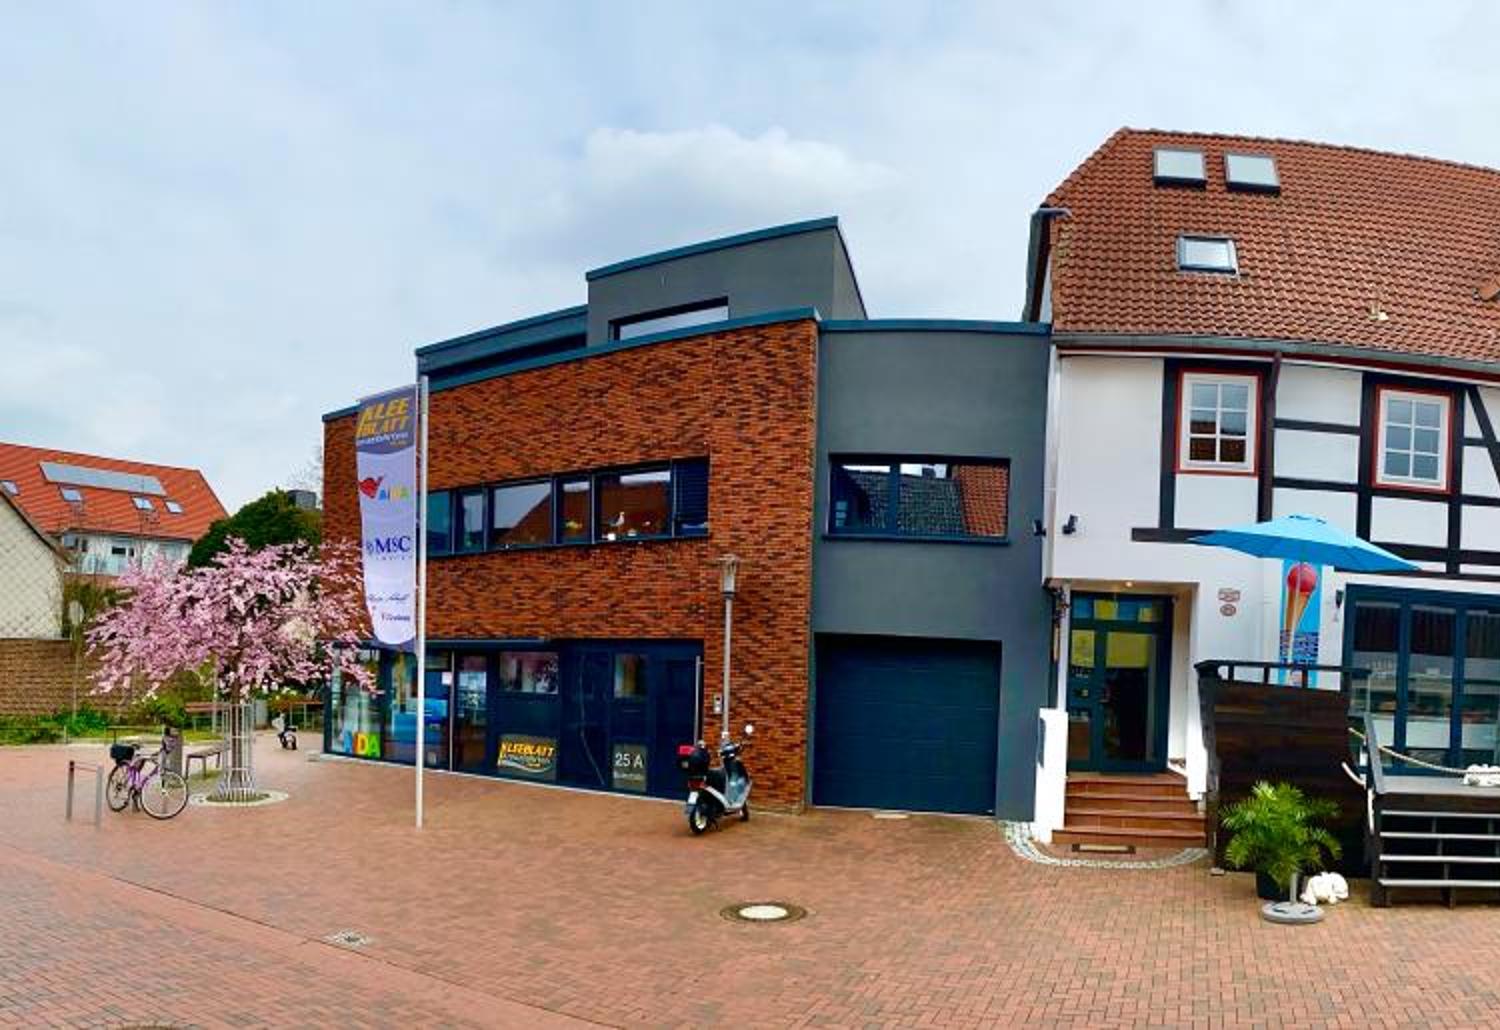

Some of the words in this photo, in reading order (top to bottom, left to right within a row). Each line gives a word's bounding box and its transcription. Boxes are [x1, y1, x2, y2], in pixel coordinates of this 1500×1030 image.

[376, 535, 411, 551] MSC
[343, 731, 380, 757] AIDA
[615, 752, 631, 767] 25
[633, 753, 644, 769] A
